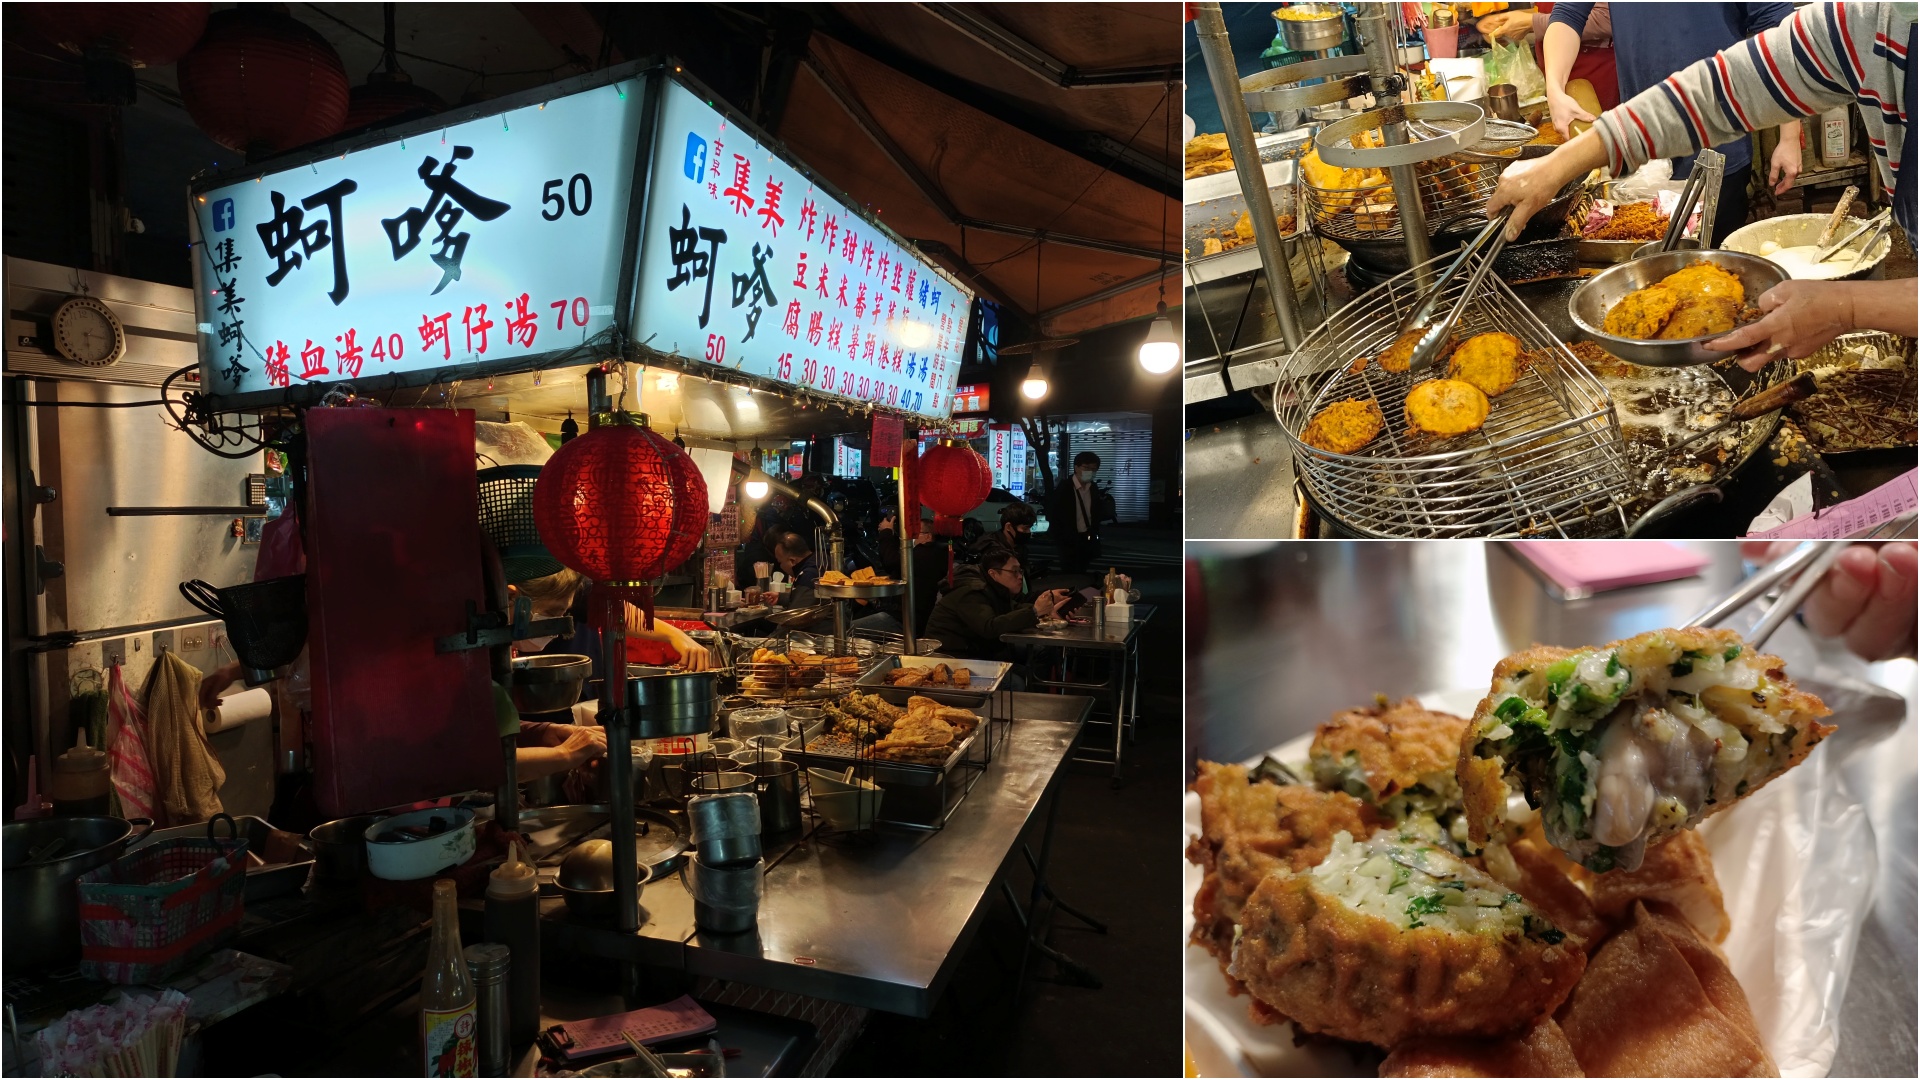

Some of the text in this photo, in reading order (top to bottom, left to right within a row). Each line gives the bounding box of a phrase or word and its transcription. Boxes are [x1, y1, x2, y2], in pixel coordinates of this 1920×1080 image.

[708, 137, 725, 200] 古早味
[723, 153, 785, 239] 集美
[255, 144, 593, 307] 蚵嗲 50
[666, 202, 779, 344] 蚵嗲
[777, 196, 818, 381] 炸豆腐 15
[213, 237, 250, 390] 集美蚵嗲
[418, 292, 539, 361] 蚵仔湯
[550, 296, 590, 332] 70
[821, 228, 858, 390] 甜米糕 30
[900, 278, 930, 409] 豬湯 40
[917, 286, 942, 383] 蚵湯
[705, 333, 726, 364] 50
[801, 358, 817, 385] 30
[841, 371, 855, 396] 30
[856, 375, 870, 399] 30
[872, 380, 885, 402] 30
[886, 384, 899, 406] 30
[995, 432, 1003, 470] SANLUX
